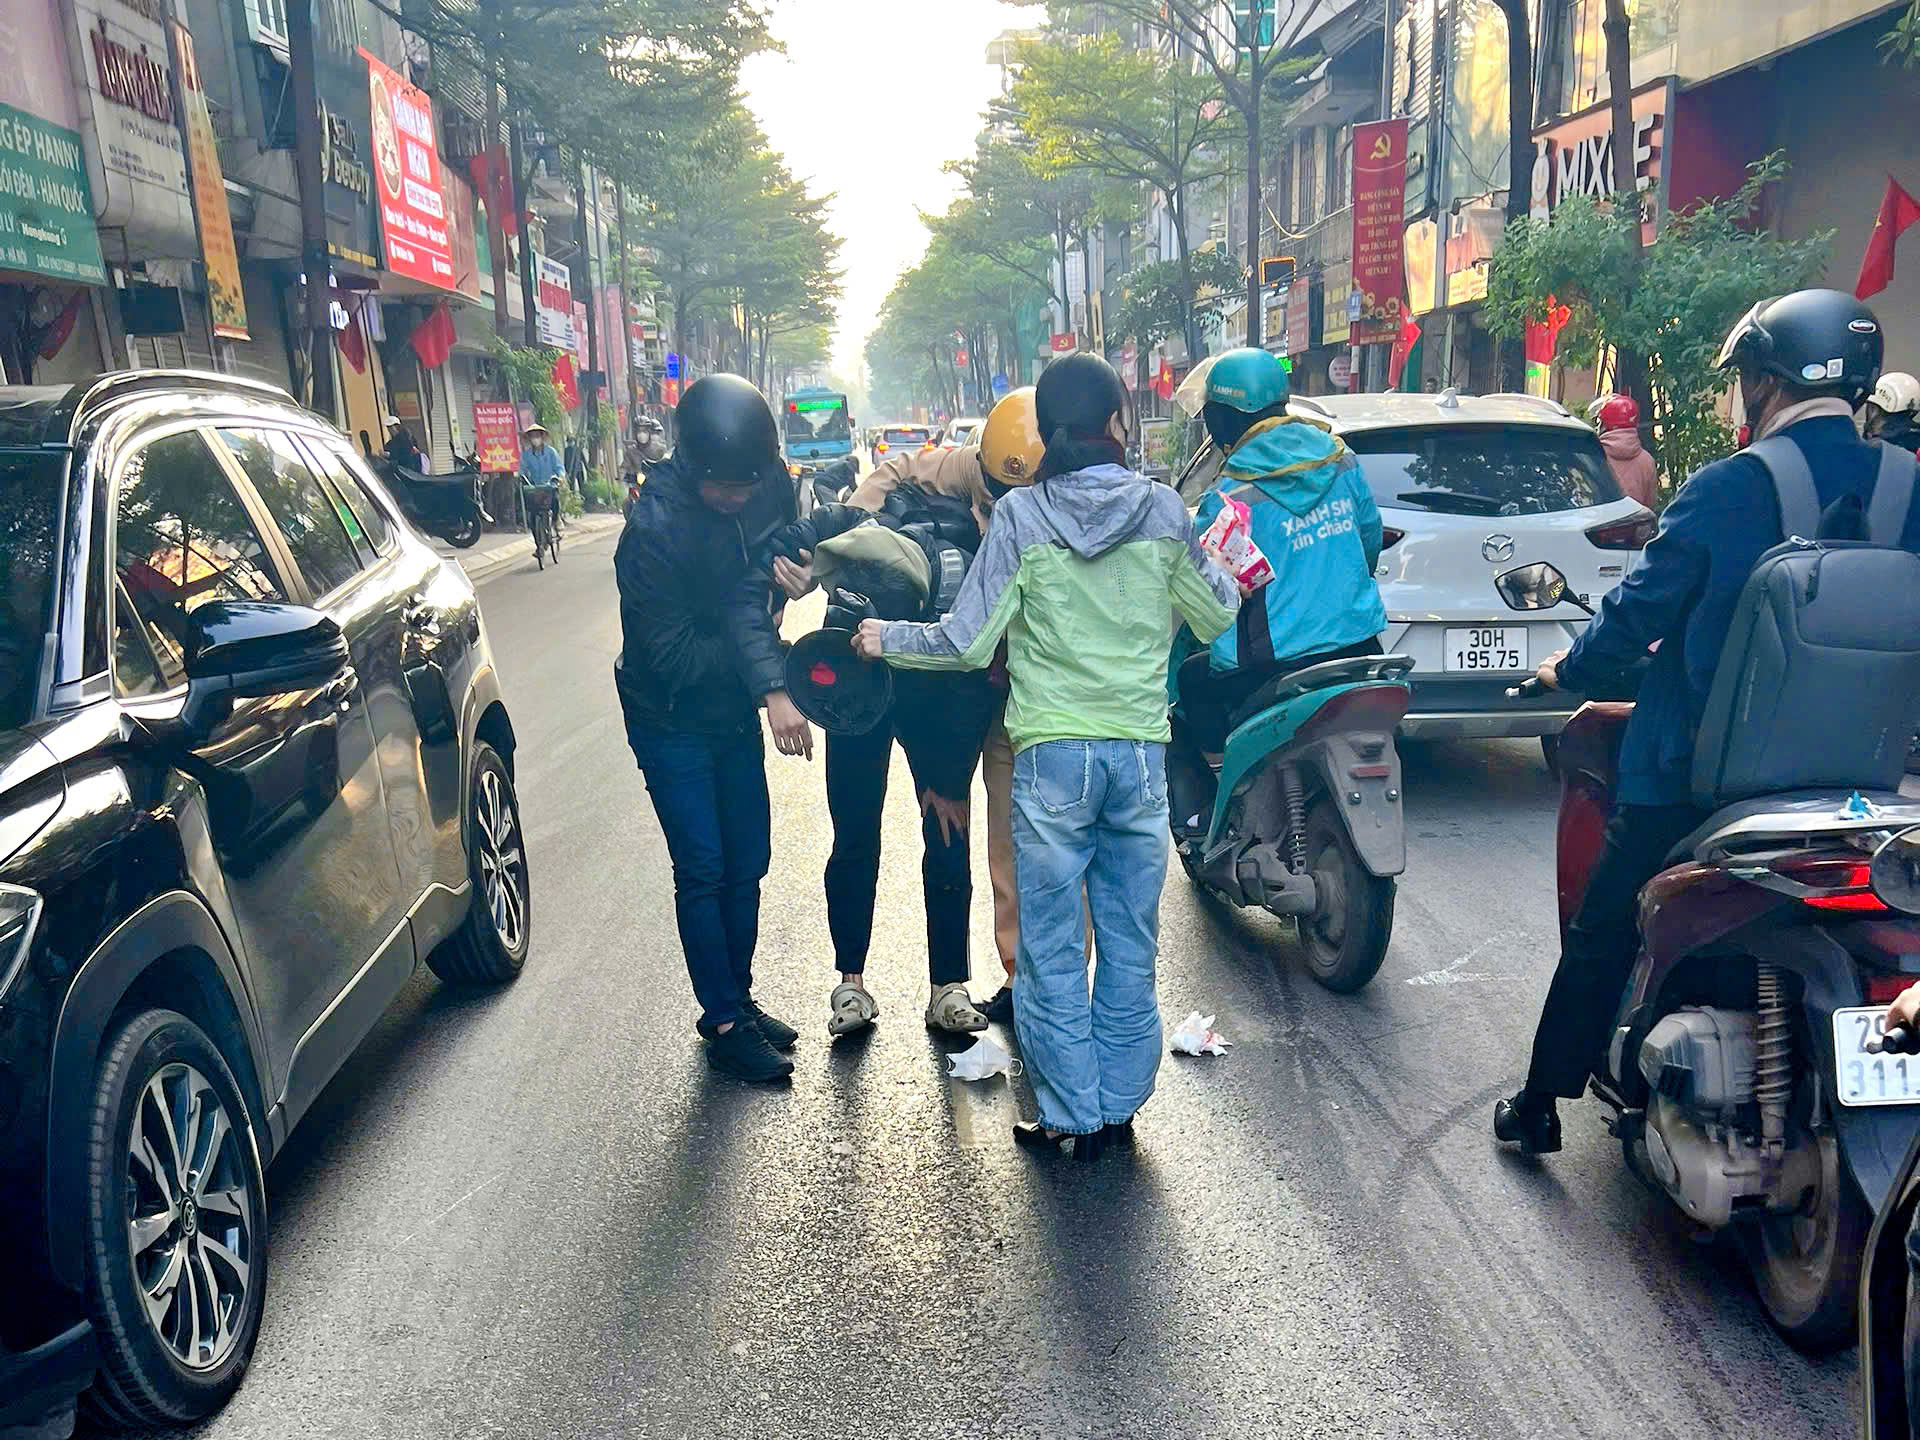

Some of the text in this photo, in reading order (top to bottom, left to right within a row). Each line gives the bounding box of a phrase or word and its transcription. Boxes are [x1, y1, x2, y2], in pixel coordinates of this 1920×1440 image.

[13, 116, 33, 155] ÉP
[33, 131, 81, 172] HANNY
[1281, 503, 1331, 537] XANH
[1291, 532, 1315, 552] xin
[1469, 629, 1505, 648] 30H
[1457, 650, 1519, 669] 195.75
